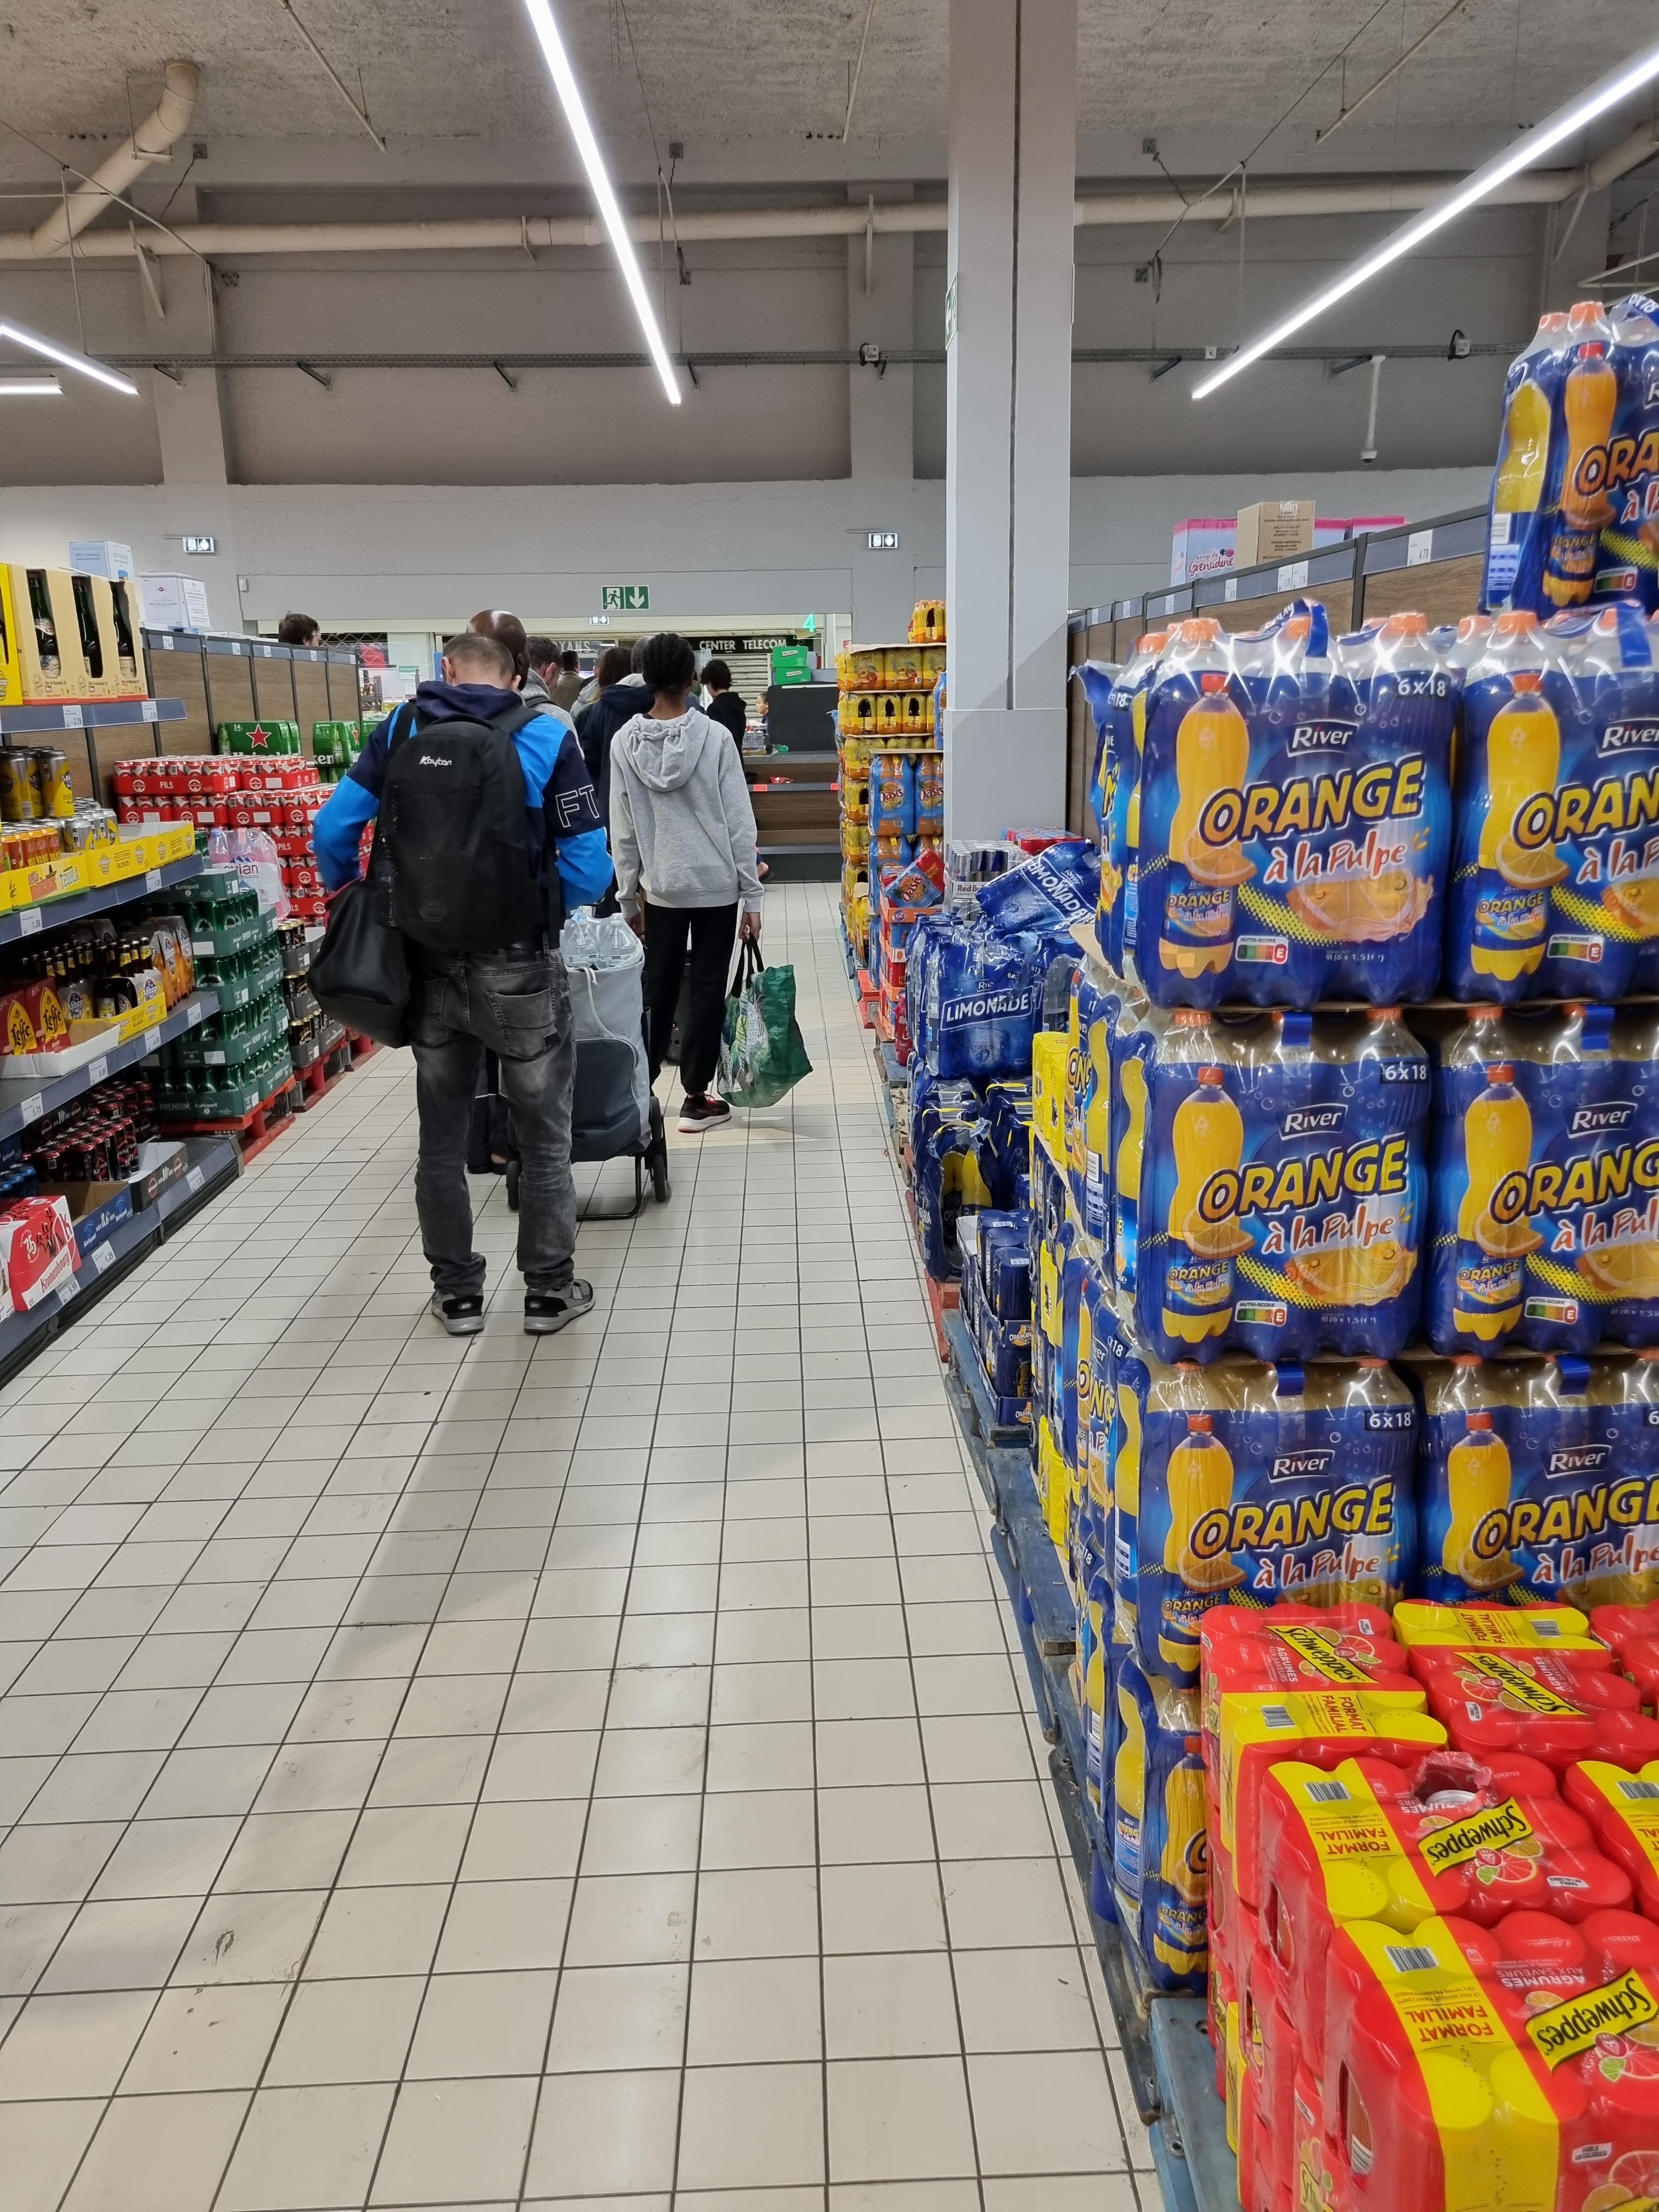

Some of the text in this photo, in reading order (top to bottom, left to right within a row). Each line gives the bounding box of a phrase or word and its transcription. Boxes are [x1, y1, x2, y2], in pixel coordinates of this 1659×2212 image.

[1622, 489, 1639, 524] à
[1189, 556, 1234, 578] Grenadine
[803, 613, 816, 633] 4
[699, 639, 787, 651] CENTER TELECOM
[1291, 727, 1353, 750] River
[879, 787, 904, 803] Oasis
[919, 786, 944, 802] Oasis
[1199, 757, 1426, 846] ORANGE
[556, 785, 600, 828] FT
[1266, 832, 1406, 881] à la Pulpe
[1578, 845, 1601, 884] à
[1610, 838, 1637, 879] la
[60, 866, 80, 889] TEQUILA
[902, 876, 923, 902] Oasis
[957, 883, 971, 891] Red
[1168, 889, 1231, 908] ORANGE
[1479, 892, 1544, 915] ORANGE
[891, 911, 908, 922] Oasis
[1276, 948, 1285, 959] E
[1590, 947, 1599, 957] E
[946, 992, 1029, 1023] LIMONADE
[42, 1005, 61, 1034] Leffe
[11, 1021, 30, 1050] Leffe
[32, 1105, 42, 1116] 5.75
[1285, 1110, 1342, 1132] River
[1573, 1108, 1630, 1131] River
[1199, 1135, 1409, 1223] ORANGE
[1263, 1205, 1395, 1254] à la Pulpe
[1552, 1218, 1573, 1252] à
[1583, 1212, 1607, 1250] la
[40, 1252, 70, 1294] Kronenbourg
[1168, 1260, 1229, 1281] ORANGE
[1459, 1259, 1520, 1282] ORANGE
[68, 1282, 78, 1294] 9.99
[1276, 1312, 1284, 1322] E
[1567, 1310, 1575, 1320] E
[1273, 1455, 1330, 1476] River
[1549, 1451, 1606, 1471] River
[1190, 1476, 1395, 1560] ORANGE
[1255, 1543, 1379, 1589] à la Pulpe
[1532, 1558, 1554, 1583] à
[1560, 1548, 1584, 1583] la
[1164, 1593, 1222, 1612] ORANGE
[1460, 1612, 1488, 1642] FORMAT
[1483, 1612, 1506, 1644] FAMILIAL
[1268, 1645, 1288, 1683] AUX SAVEURS
[1274, 1626, 1361, 1683] Schweppes
[1275, 1645, 1299, 1683] AGRUMES
[1472, 1652, 1573, 1713] Schweppes
[1532, 1656, 1565, 1692] AGRUMES
[1321, 1694, 1348, 1733] FAMILIAL
[1338, 1695, 1367, 1732] FORMAT
[1315, 1827, 1388, 1842] FAMILIAL
[1426, 1804, 1527, 1861] Schweppes
[1326, 1841, 1391, 1855] FORMAT
[1496, 1966, 1584, 1977] AUX SAVEURS
[1501, 1974, 1587, 1988] AGRUMES
[1404, 2004, 1489, 2023] FAMILIAL
[1537, 1976, 1652, 2046] Schweppes
[1419, 2023, 1494, 2043] FORMAT
